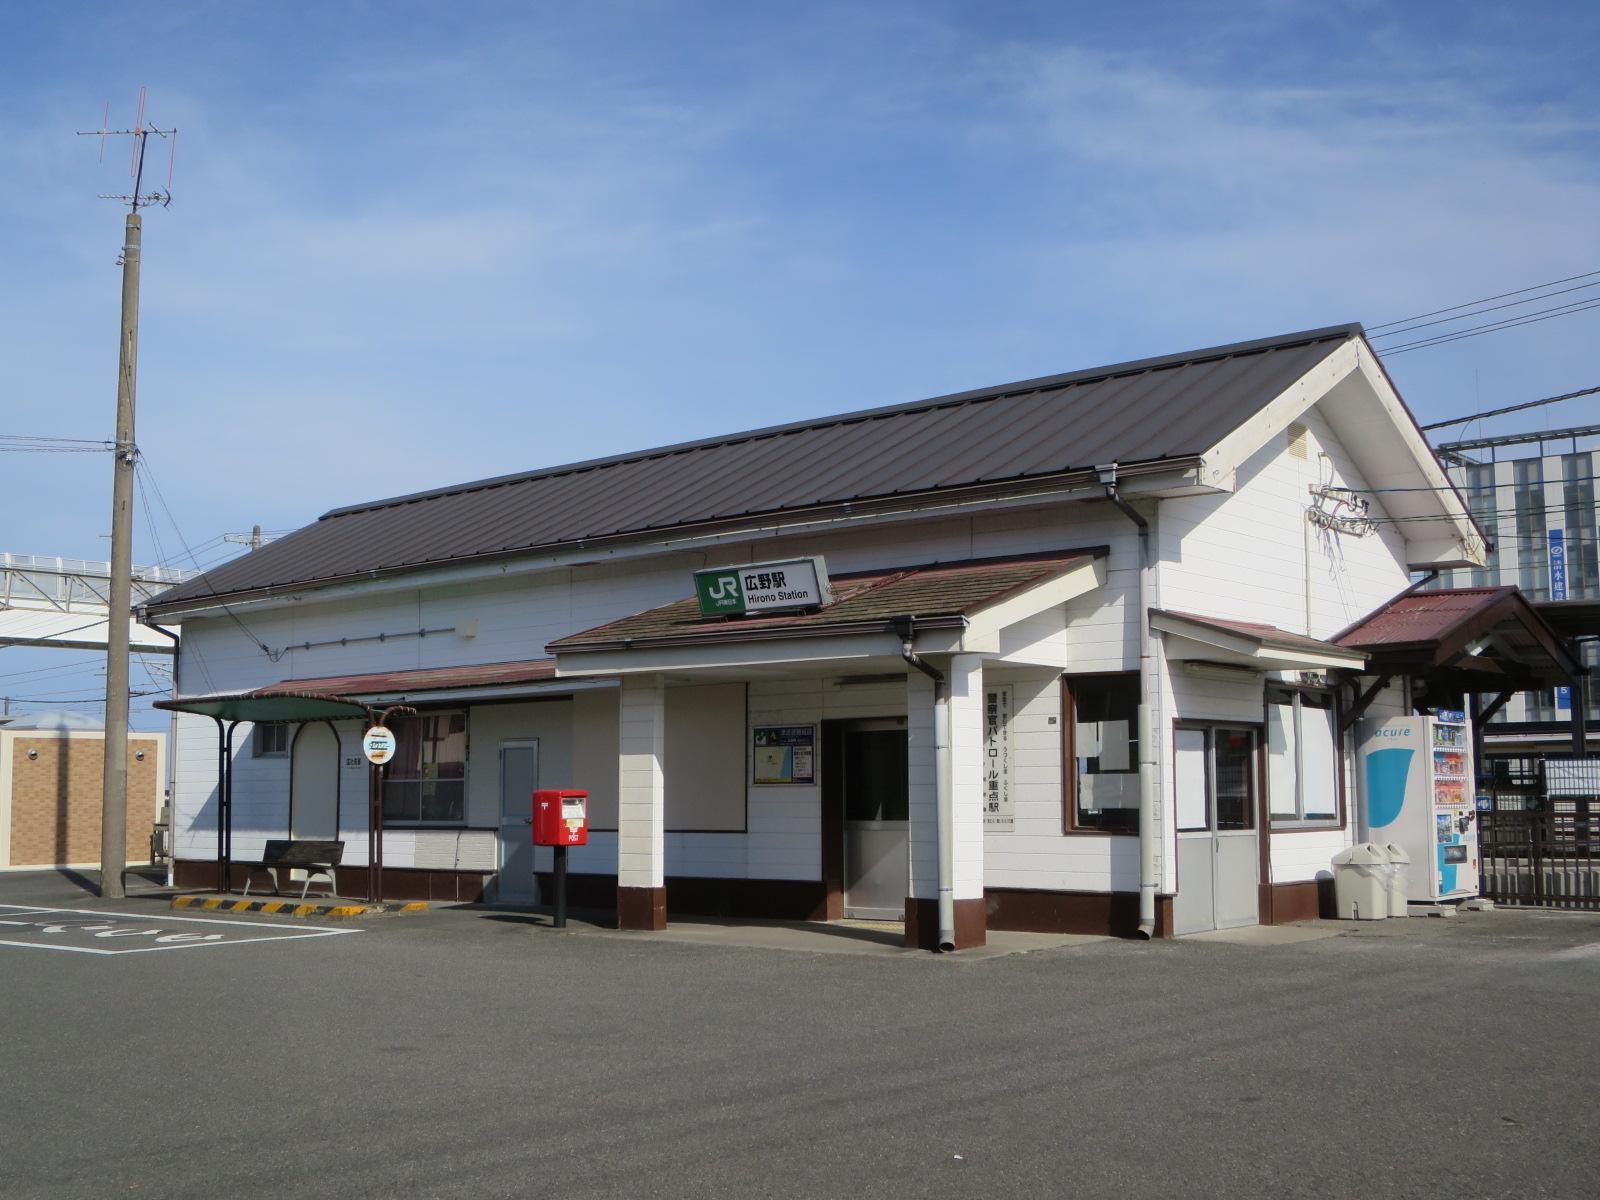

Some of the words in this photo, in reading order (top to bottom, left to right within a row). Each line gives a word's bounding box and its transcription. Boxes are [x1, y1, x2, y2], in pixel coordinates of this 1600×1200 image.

[709, 577, 739, 599] JR
[744, 571, 787, 591] 広野駅
[748, 593, 776, 604] Hirono
[778, 590, 808, 602] Station
[1375, 727, 1411, 737] acure
